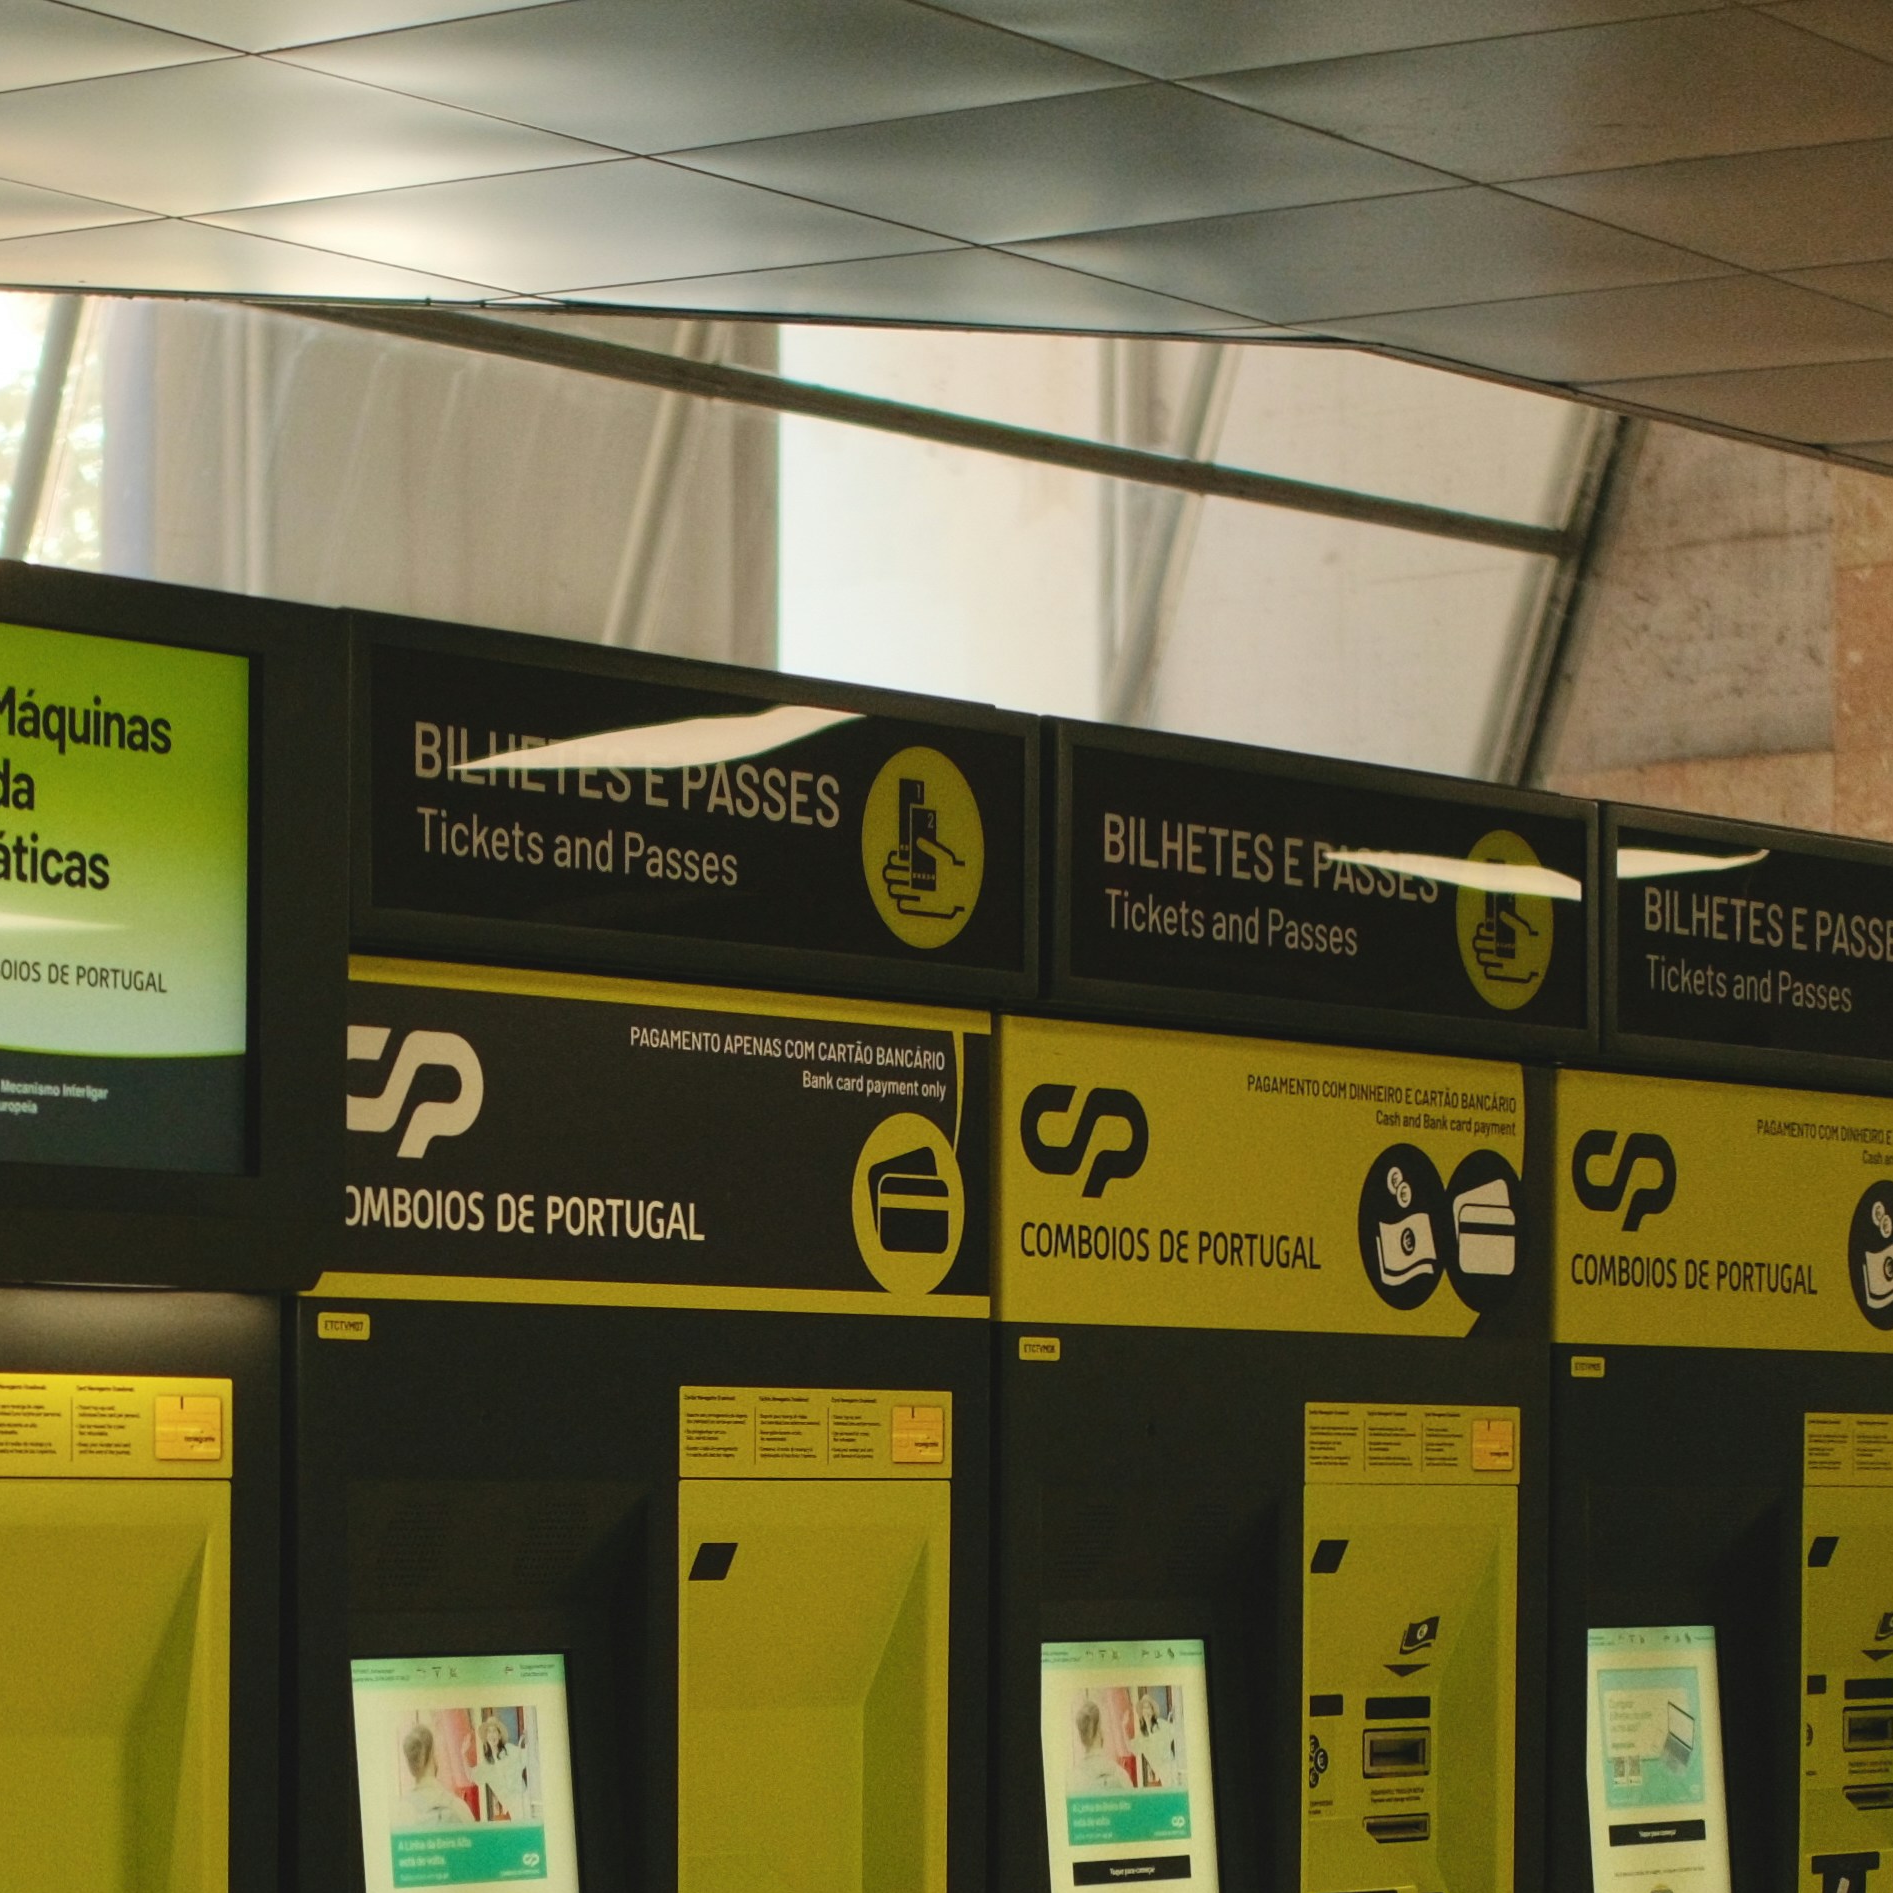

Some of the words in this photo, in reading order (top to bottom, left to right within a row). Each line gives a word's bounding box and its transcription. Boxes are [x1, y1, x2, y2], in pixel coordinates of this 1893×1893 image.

[415, 721, 631, 804] BILHETES
[645, 752, 668, 808] E
[682, 757, 840, 828] PASSES
[417, 806, 544, 866] Tickets
[553, 828, 613, 873] and
[624, 830, 738, 886] Passes
[1104, 813, 1274, 883] BILHETES
[1283, 838, 1303, 885] E
[1313, 840, 1439, 903] PASSES
[1106, 888, 1205, 939] Tickets
[1212, 906, 1259, 945] and
[1267, 908, 1358, 956] Passes
[1645, 886, 1784, 948] BILHETES
[1791, 907, 1808, 950] E
[47, 962, 70, 985] DE
[75, 965, 167, 994] PORTUGAL
[1646, 955, 1727, 998] Tickets
[1733, 969, 1772, 1003] and
[1778, 971, 1852, 1013] Passes
[630, 1026, 721, 1053] PAGAMENTO
[724, 1035, 781, 1058] APENAS
[785, 1039, 815, 1061] COM
[818, 1041, 873, 1064] CARTÃO
[876, 1045, 945, 1071] BANCÁRIO
[0, 1079, 59, 1097] Mecanismo
[803, 1070, 834, 1090] Bank
[836, 1075, 864, 1092] card
[866, 1079, 919, 1098] payment
[921, 1081, 946, 1102] only
[1248, 1074, 1319, 1097] PAGAMENTO
[1322, 1080, 1347, 1099] COM
[1350, 1082, 1402, 1104] DINHEIRO
[1406, 1087, 1413, 1105] E
[1415, 1087, 1458, 1108] CARTÃO
[1461, 1091, 1516, 1114] BANCÁRIO
[1376, 1110, 1400, 1127] Cash
[1403, 1112, 1421, 1129] and
[1423, 1114, 1448, 1131] Bank
[1450, 1118, 1471, 1132] card
[1474, 1121, 1516, 1137] payment
[1757, 1119, 1817, 1138] PAGAMENTO
[1819, 1124, 1838, 1141] COM
[1886, 1130, 1892, 1145] E
[1862, 1150, 1883, 1165] Cash
[497, 1193, 535, 1235] DE
[547, 1195, 706, 1241] PORTUGAL
[1020, 1220, 1150, 1263] COMBOIOS
[1159, 1228, 1189, 1265] DE
[1198, 1230, 1321, 1271] PORTUGAL
[1571, 1253, 1678, 1290] COMBOIOS
[1684, 1258, 1709, 1290] DE
[1716, 1260, 1818, 1295] PORTUGAL
